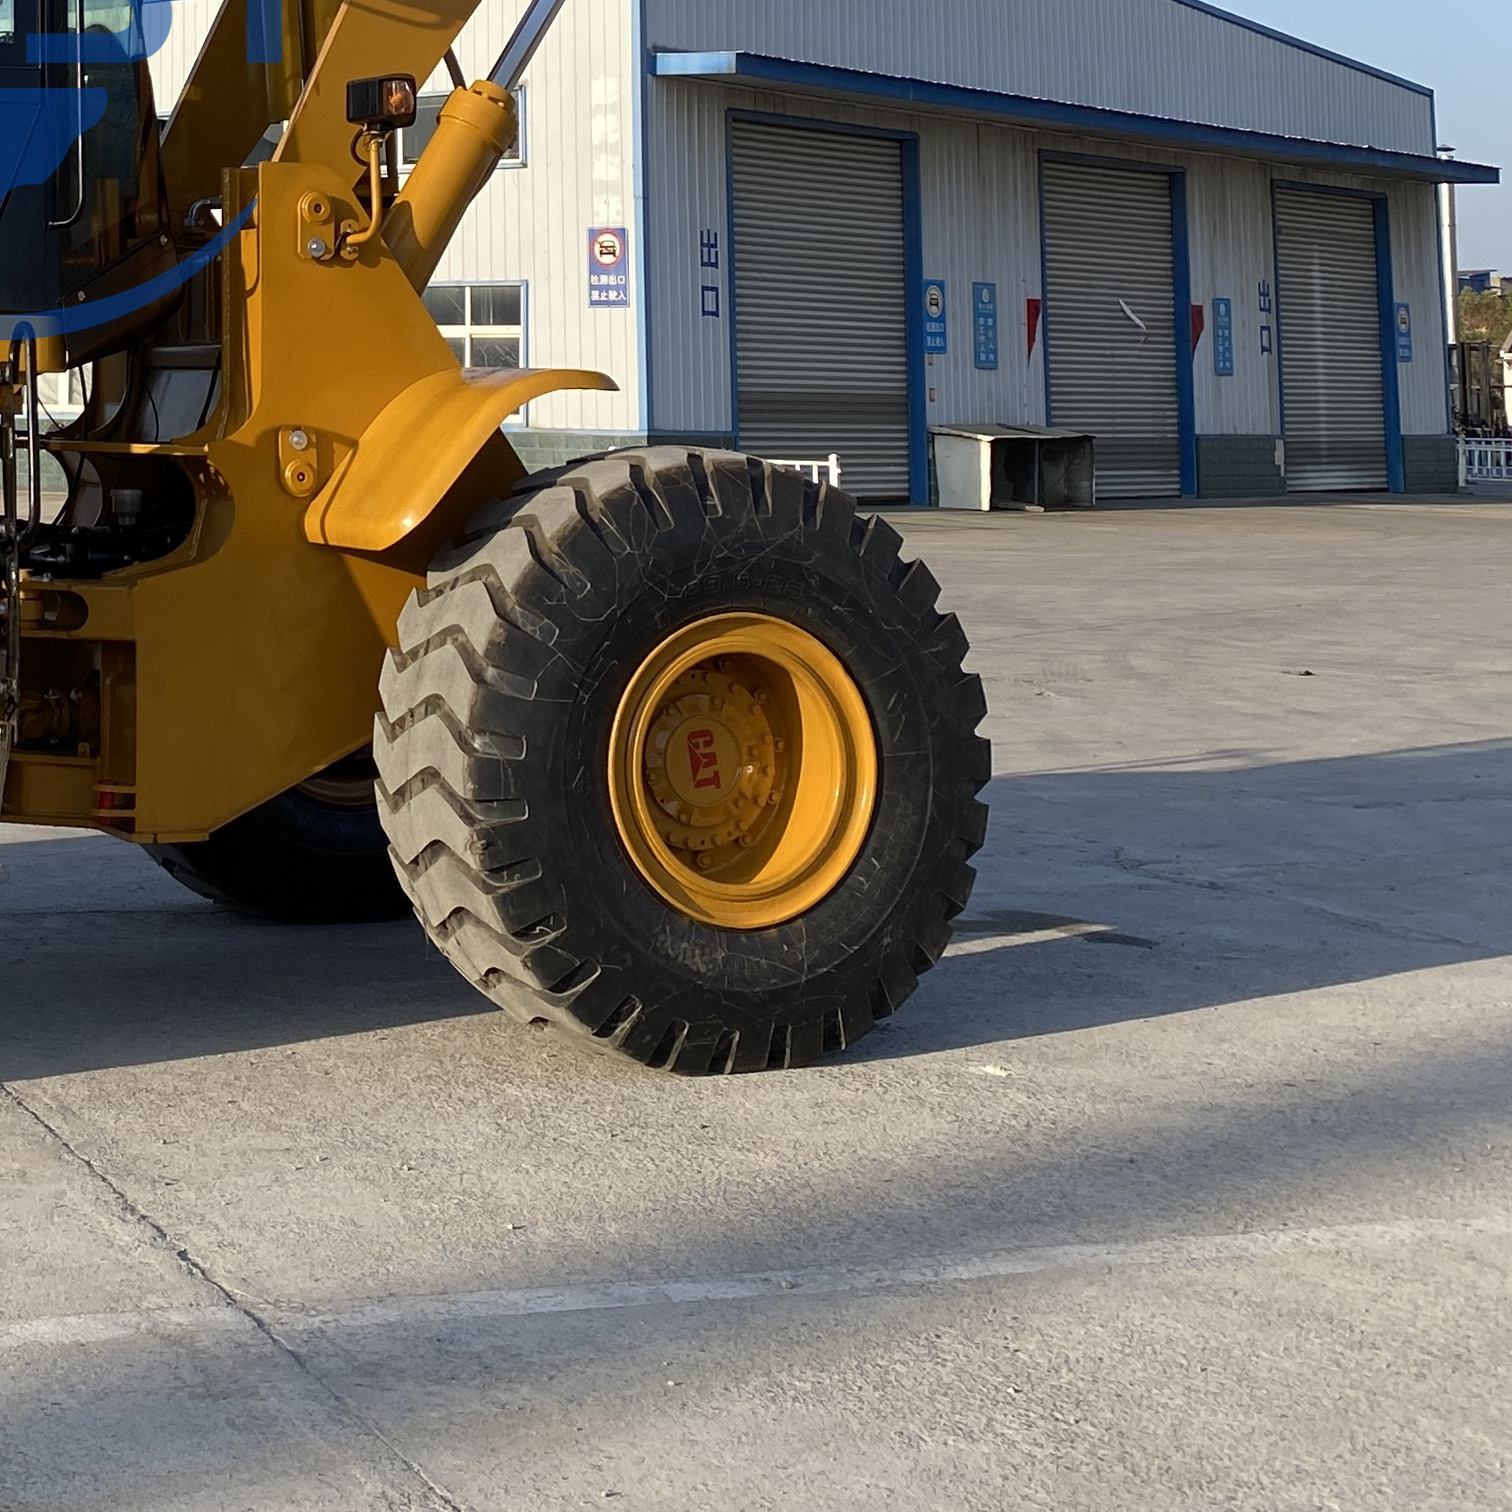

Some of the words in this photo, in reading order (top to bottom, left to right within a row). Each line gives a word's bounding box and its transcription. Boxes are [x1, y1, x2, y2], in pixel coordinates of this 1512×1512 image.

[700, 229, 719, 318] 出口
[1258, 280, 1272, 355] 出口
[687, 729, 722, 790] CAT
